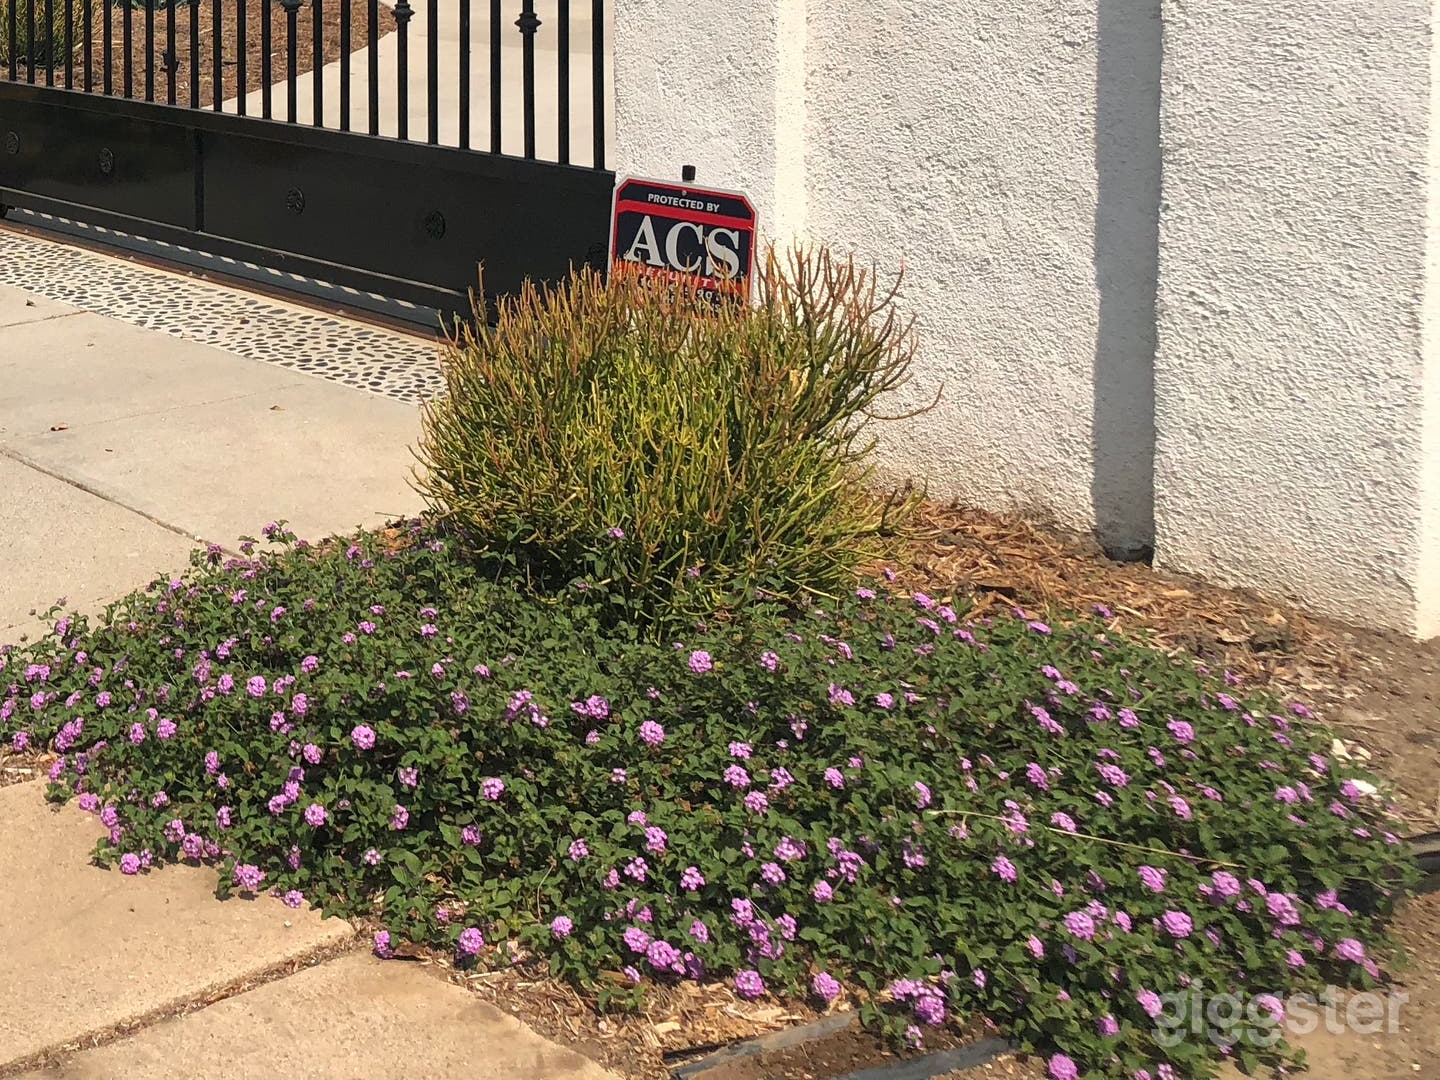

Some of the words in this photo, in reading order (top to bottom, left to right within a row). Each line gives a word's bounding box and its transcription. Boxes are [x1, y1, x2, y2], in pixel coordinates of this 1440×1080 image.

[647, 193, 704, 210] PROTECTED
[706, 202, 720, 213] BY
[623, 215, 740, 280] ACS
